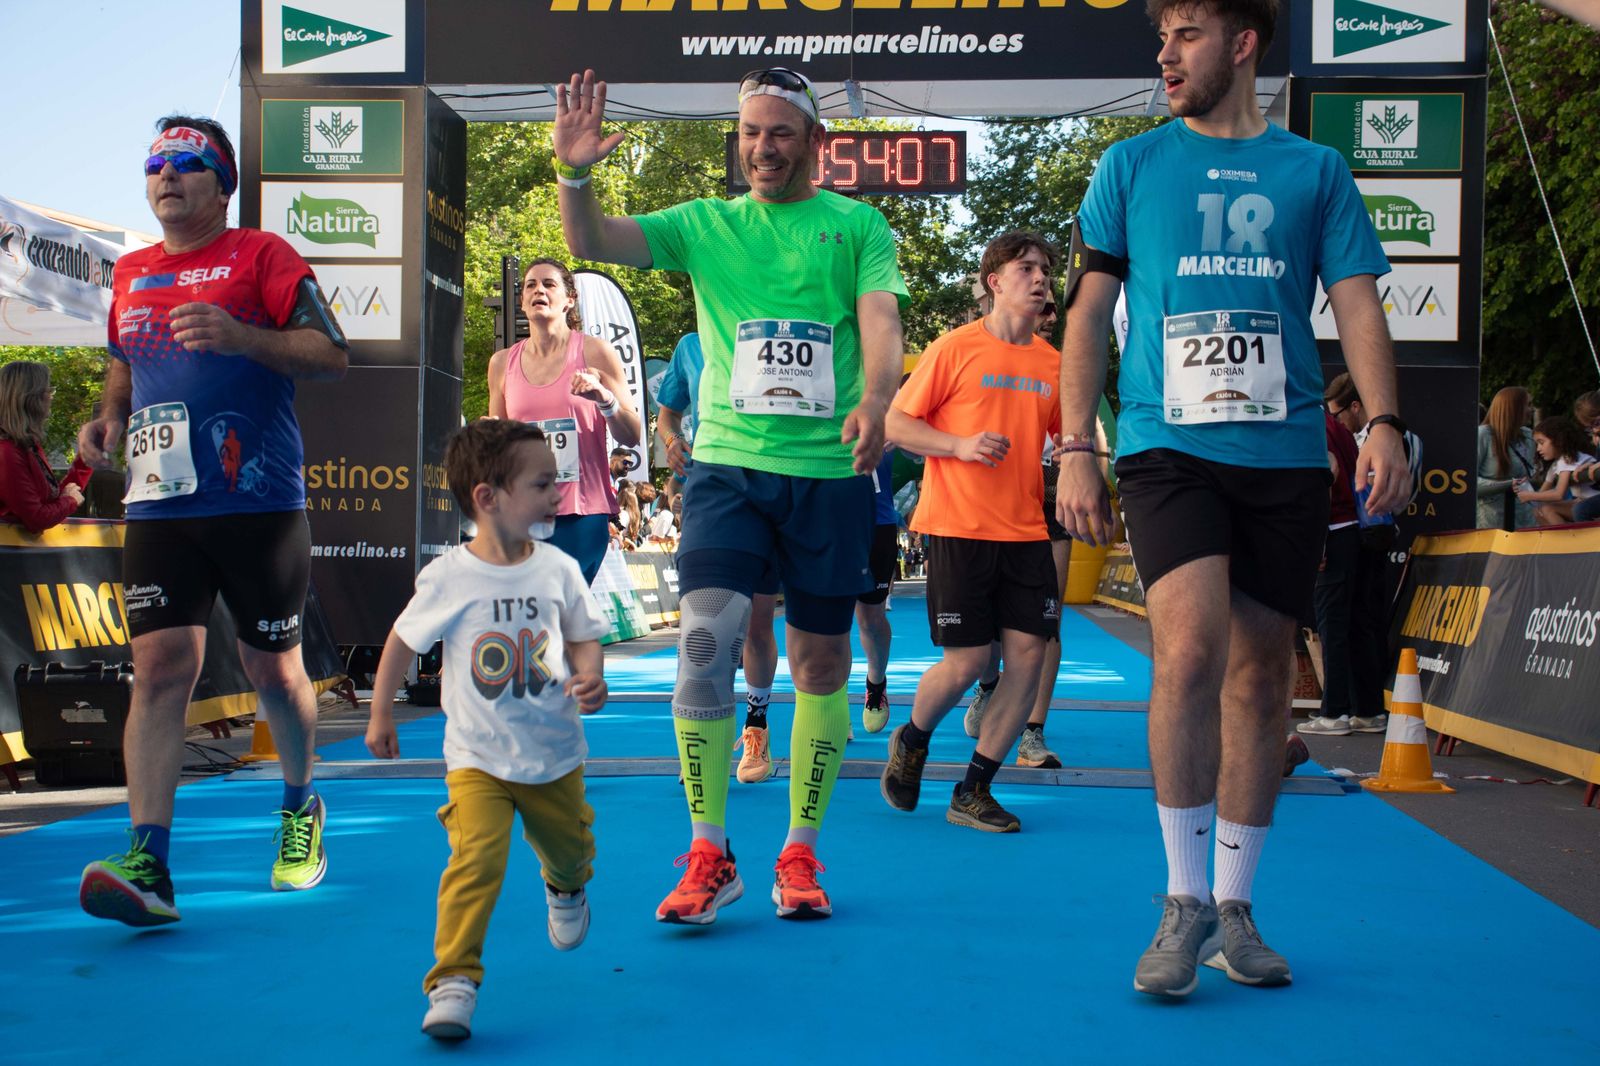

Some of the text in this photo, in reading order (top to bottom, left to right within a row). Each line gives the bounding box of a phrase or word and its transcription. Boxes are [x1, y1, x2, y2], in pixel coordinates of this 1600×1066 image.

[297, 28, 325, 42] Corte
[326, 26, 367, 46] Inglés
[1349, 18, 1379, 31] Corte
[1379, 14, 1424, 35] Inglés
[681, 26, 1024, 62] www.mpmarcelino.es
[1354, 101, 1362, 149] fundación
[303, 155, 363, 163] CAJA RURAL
[1353, 150, 1418, 159] CAJA RURAL
[1220, 169, 1257, 178] OXIMESA
[336, 207, 359, 215] Sierra
[1388, 203, 1413, 212] Sierra
[288, 208, 379, 234] Natura
[1197, 193, 1275, 254] 18
[1368, 208, 1435, 232] tura
[177, 266, 232, 286] SEUR
[1176, 255, 1286, 280] MARCELINO
[757, 341, 813, 367] 430
[1183, 335, 1265, 368] 2201
[779, 368, 813, 377] ANTONIO
[1210, 367, 1244, 377] ADRIÁN
[132, 424, 174, 458] 2619
[301, 457, 409, 490] stinos
[310, 541, 406, 558] marcelino.es
[493, 597, 538, 622] IT'S
[1402, 585, 1491, 647] MARCELINO
[257, 614, 299, 633] SEUR
[1525, 597, 1600, 654] agustinos
[1525, 655, 1574, 680] GRANADA
